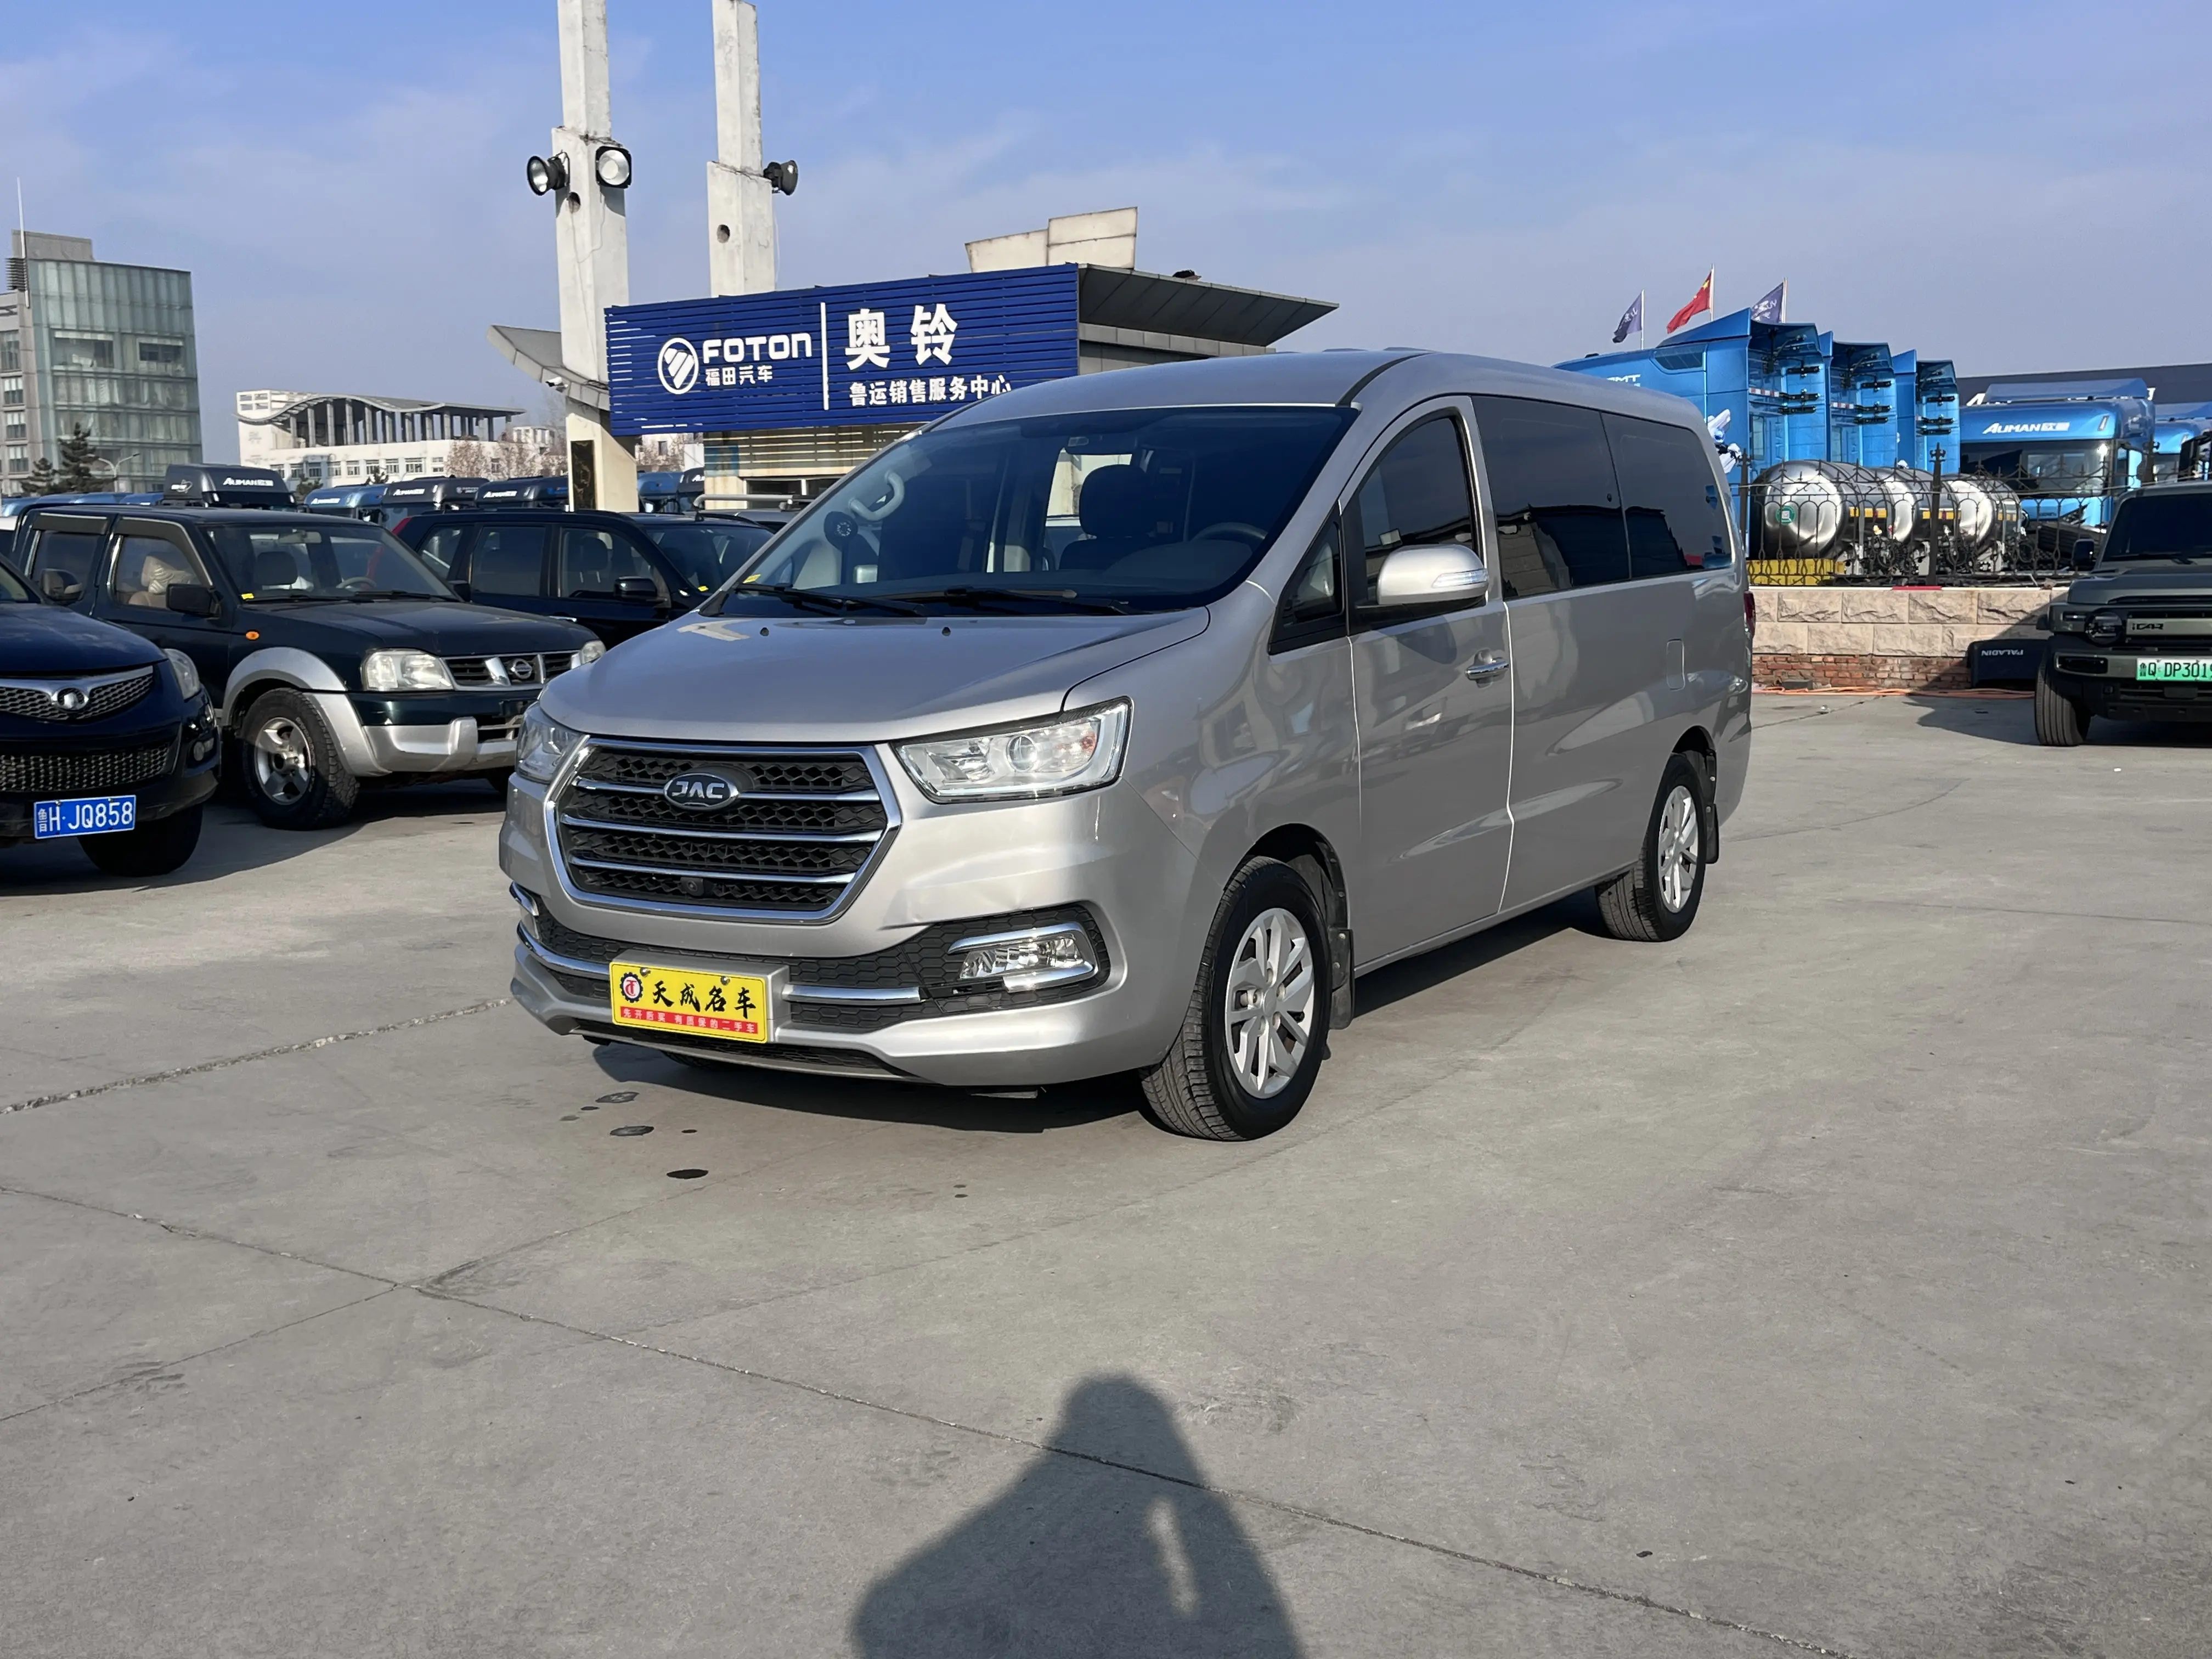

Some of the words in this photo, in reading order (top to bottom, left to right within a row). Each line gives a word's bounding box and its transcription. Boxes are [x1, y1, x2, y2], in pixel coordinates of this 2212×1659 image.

[845, 303, 958, 370] 奥铃
[705, 365, 773, 386] 福田汽车
[849, 374, 1012, 407] 鲁运销售服务中心
[2164, 662, 2212, 678] DP301
[672, 781, 725, 799] JAC
[652, 980, 756, 1019] 天成名车
